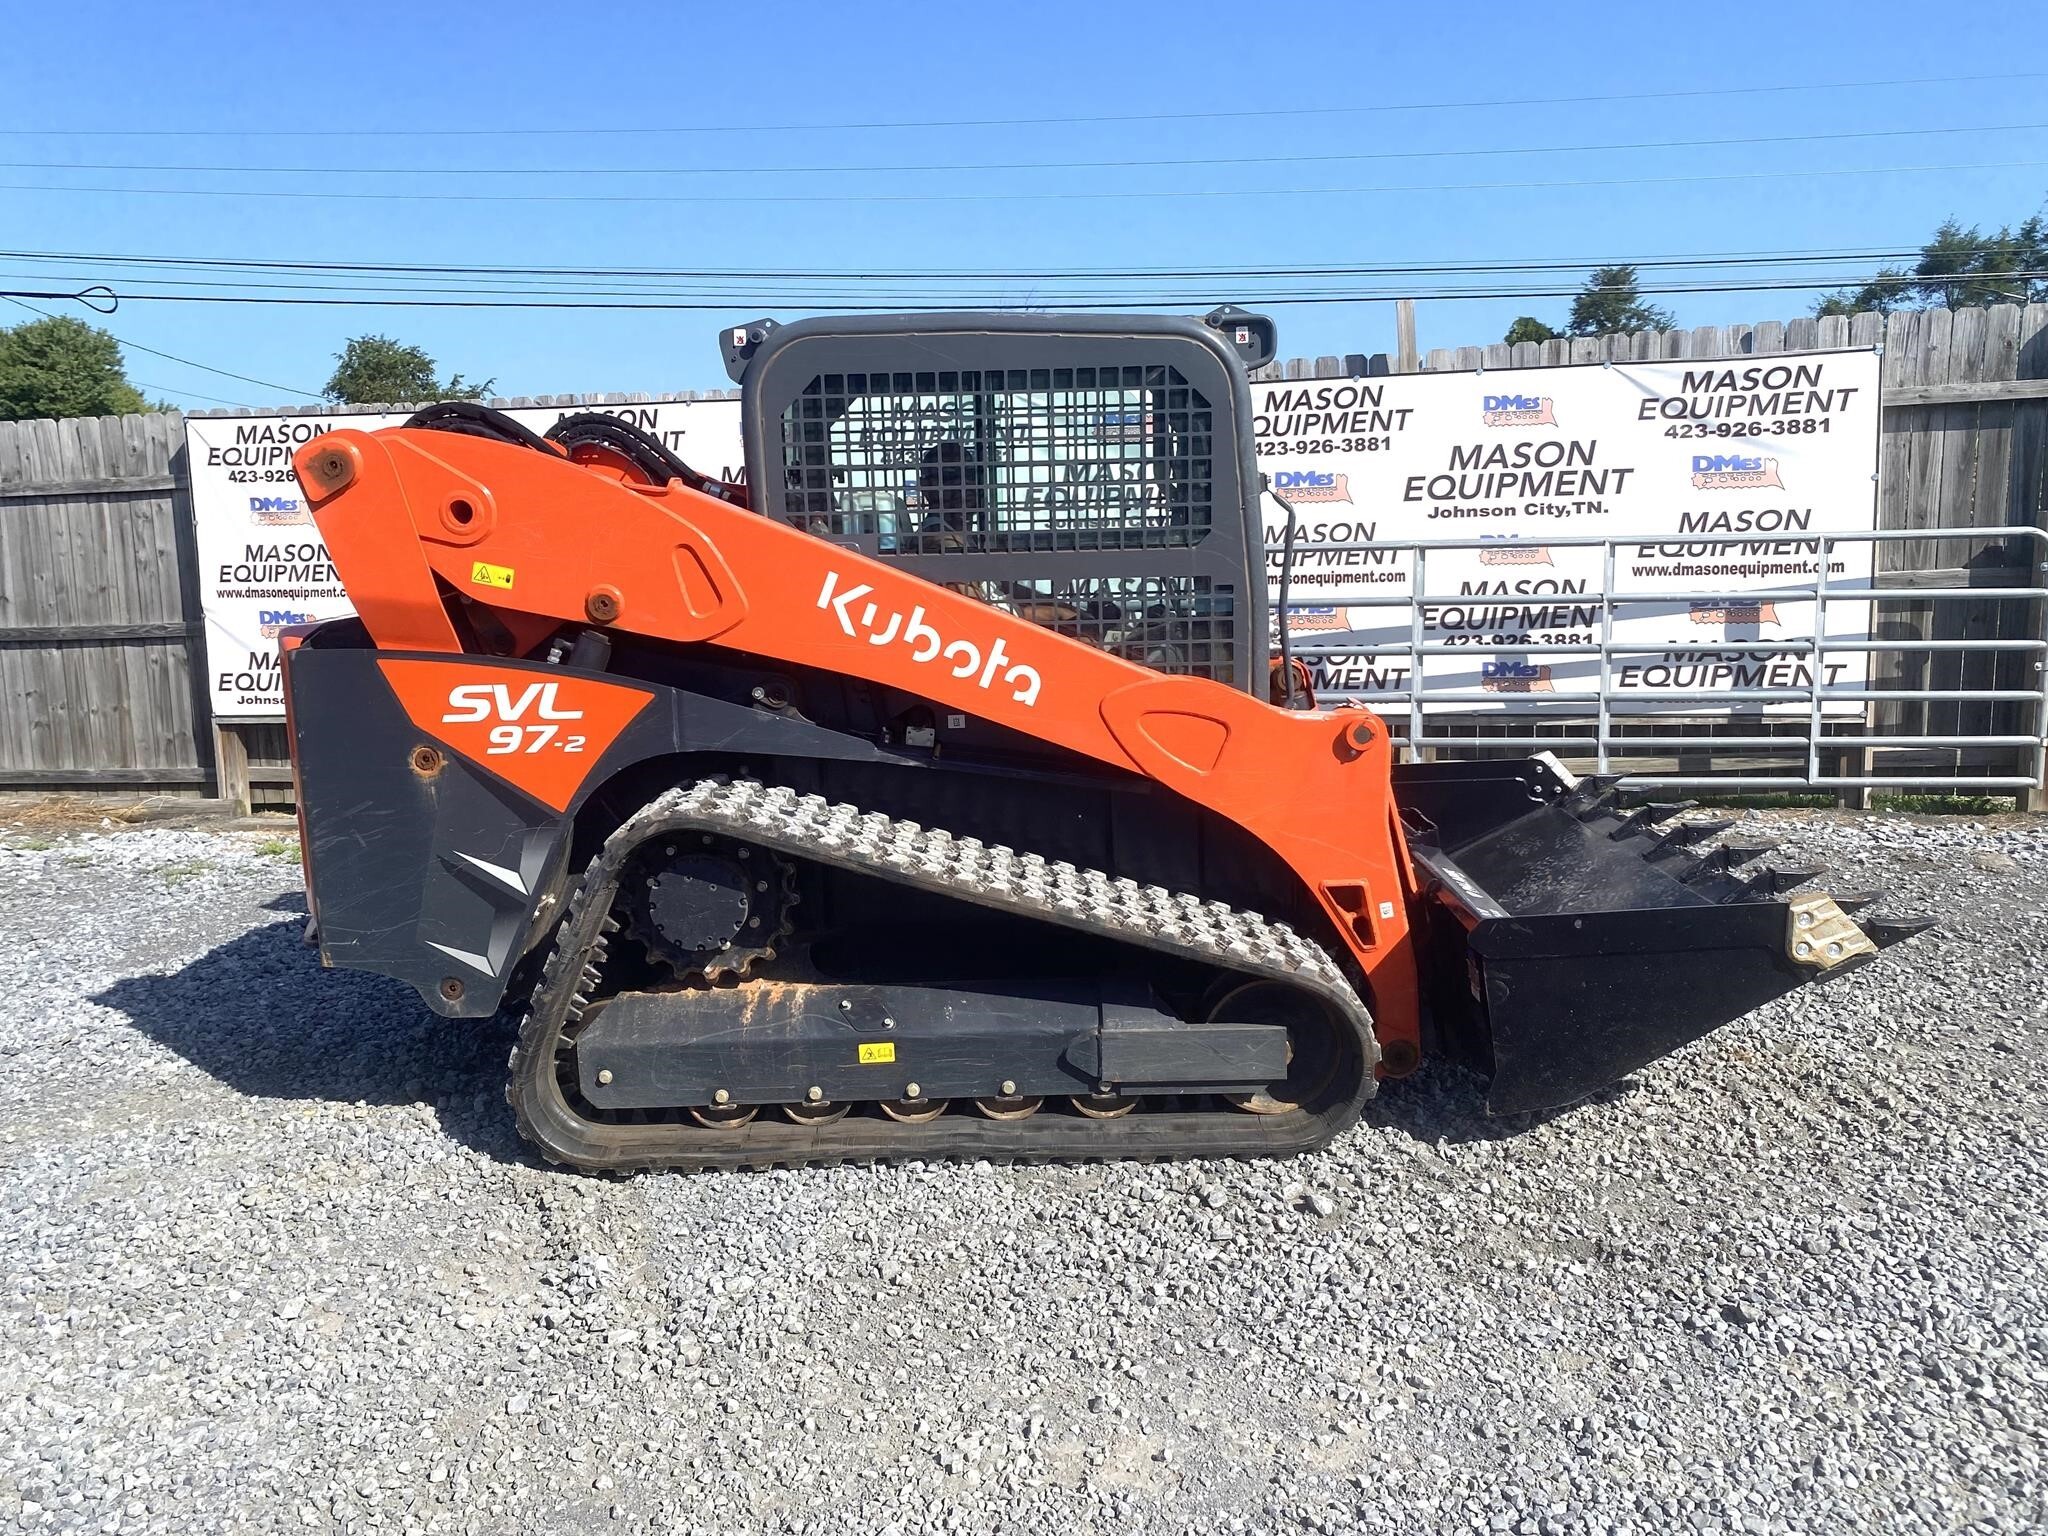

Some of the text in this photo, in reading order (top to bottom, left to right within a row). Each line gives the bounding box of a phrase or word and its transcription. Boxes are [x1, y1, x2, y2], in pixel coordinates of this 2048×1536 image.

[1681, 364, 1823, 394] MASON
[1265, 385, 1384, 413] MASON
[1638, 388, 1858, 420] EQUIPMENT
[1253, 409, 1414, 437] QUIPMENT
[1664, 418, 1830, 439] 423-926-3881
[1448, 439, 1597, 471] MASON
[228, 469, 296, 483] 423-926
[1403, 468, 1635, 502] EQUIPMENT
[1427, 505, 1518, 520] Johnson
[1678, 508, 1811, 534] MASON
[219, 564, 342, 583] EQUIPMEN
[216, 585, 346, 601] www.dmasonequipment.c
[1424, 604, 1618, 631] EQUIPMEN
[816, 570, 1042, 707] Kubota
[442, 682, 584, 723] SVL
[486, 724, 587, 755] 97-2
